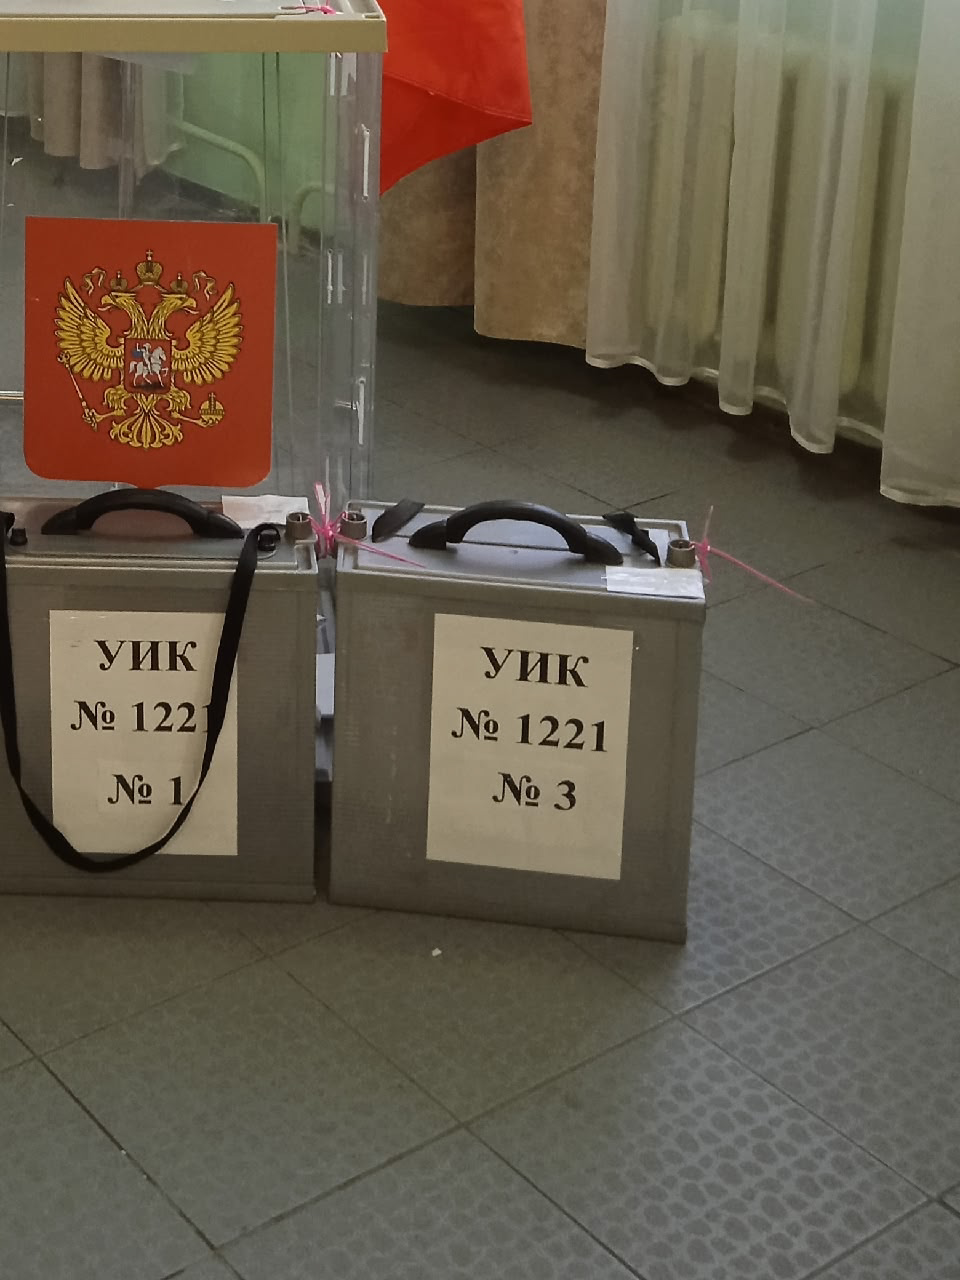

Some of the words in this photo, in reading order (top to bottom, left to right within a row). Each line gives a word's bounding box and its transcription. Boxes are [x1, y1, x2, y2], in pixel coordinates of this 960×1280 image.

[94, 640, 198, 671] УИК
[480, 646, 590, 688] УИК
[70, 700, 116, 731] №
[451, 707, 499, 742] №
[515, 714, 608, 753] 1221
[107, 774, 153, 805] №
[169, 776, 184, 806] 1
[492, 772, 540, 807] №
[553, 780, 577, 811] 3
